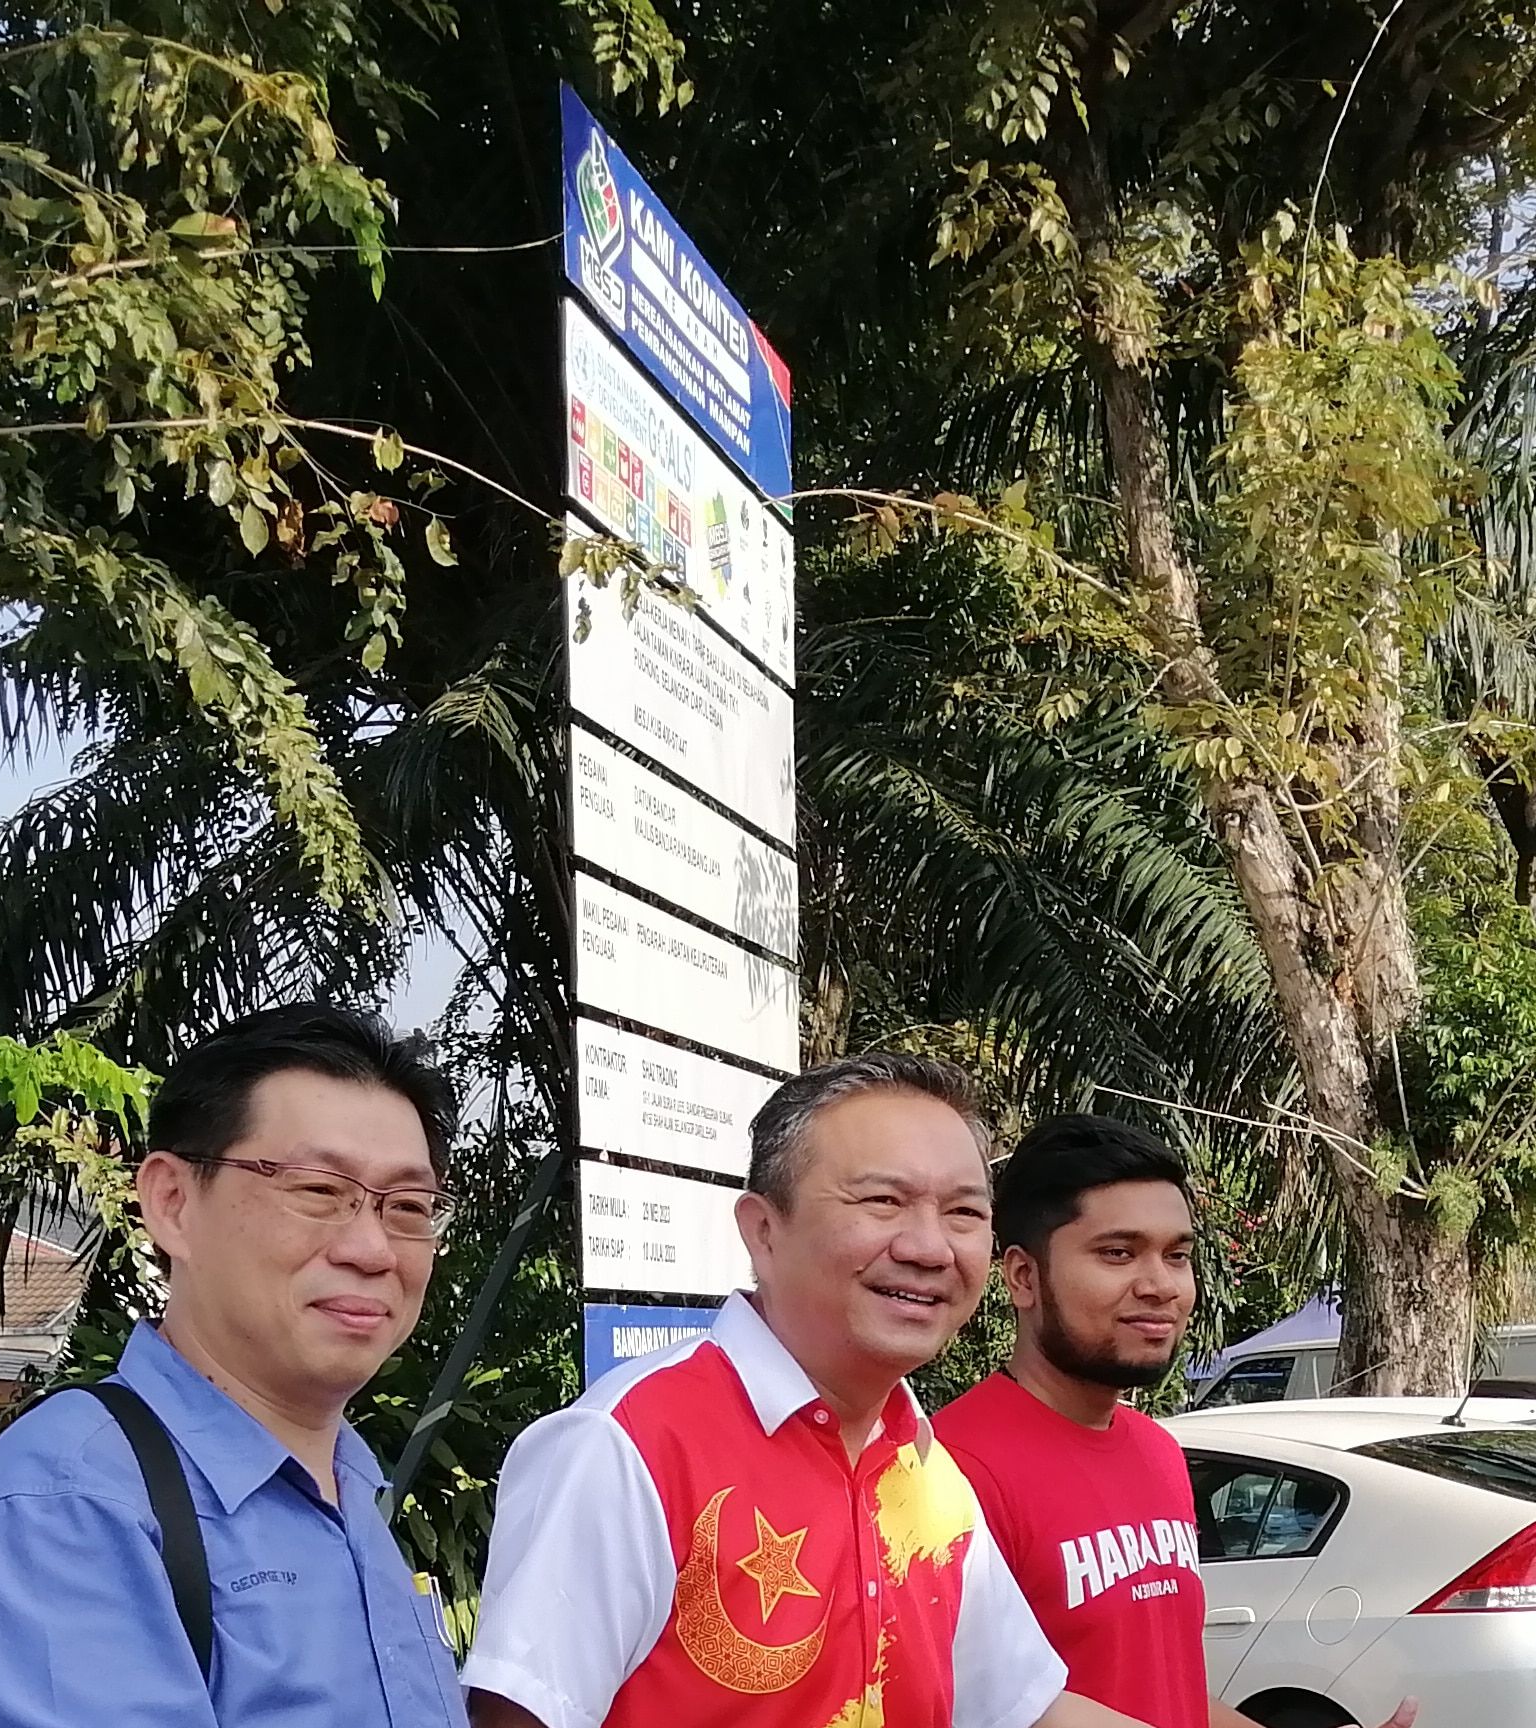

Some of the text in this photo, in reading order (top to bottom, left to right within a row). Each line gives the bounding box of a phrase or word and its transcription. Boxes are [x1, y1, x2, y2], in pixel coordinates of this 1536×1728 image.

[630, 188, 749, 365] KAMI KOMITED
[631, 283, 751, 431] MEREALISASIKAN MATLAMAT
[686, 315, 719, 361] ARAH
[597, 353, 647, 421] SUSTAINABLE
[631, 310, 750, 457] PEMBANGUNAN MAMPAN
[598, 384, 648, 449] DEVELOPMENT
[648, 407, 693, 494] GOALS
[661, 667, 689, 708] SELANGOR
[578, 752, 608, 787] PEGAWAI
[633, 785, 677, 825] DATUK BANDAR
[582, 897, 630, 938] WAKIL PEGAWAI
[585, 1043, 627, 1075] KONTRAKTOR
[588, 1193, 609, 1215] TARIKH
[588, 1235, 609, 1258] TARIKH
[610, 1236, 624, 1258] SIAP
[230, 1570, 281, 1592] GEORGE
